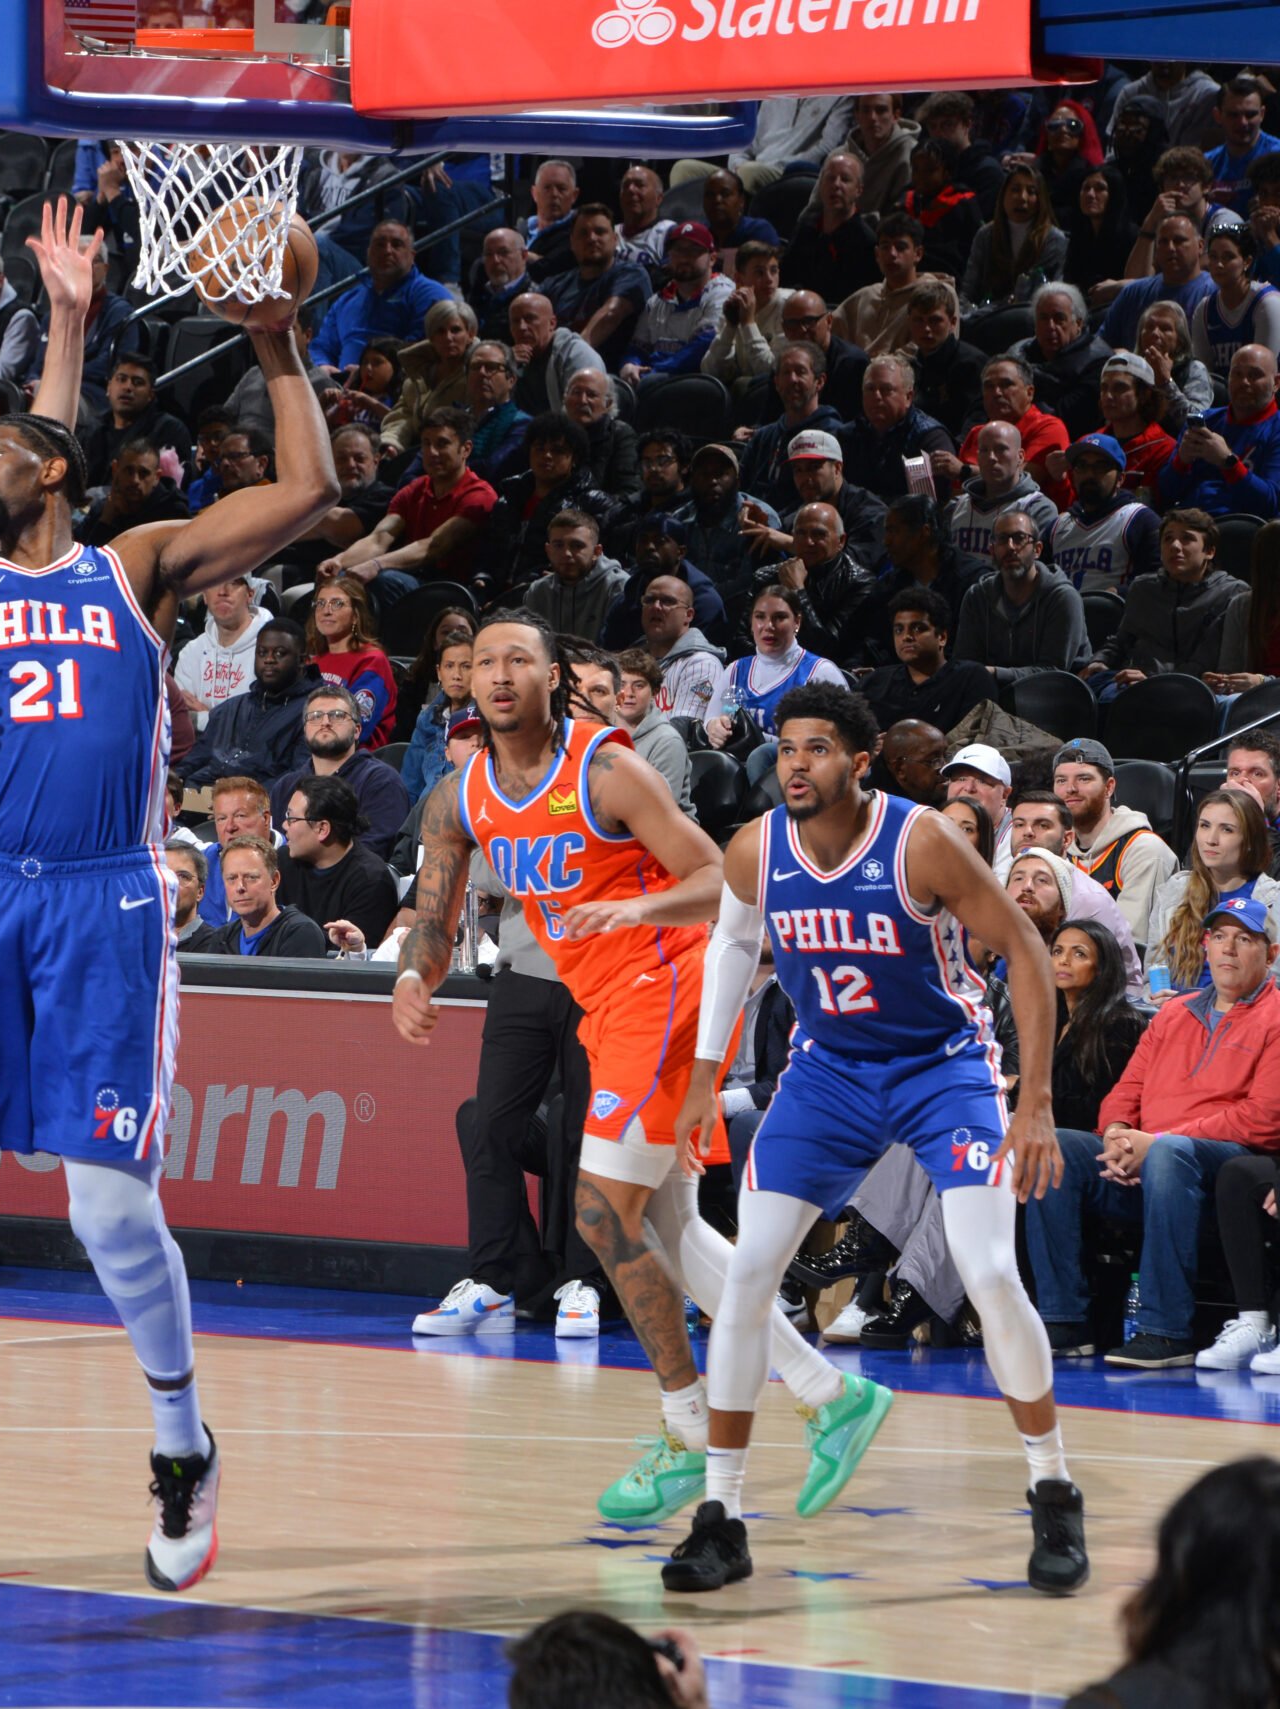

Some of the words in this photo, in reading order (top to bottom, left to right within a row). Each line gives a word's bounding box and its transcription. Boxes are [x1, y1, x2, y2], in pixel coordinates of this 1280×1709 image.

[67, 575, 111, 585] crypto.com
[9, 658, 84, 722] 21
[489, 831, 588, 896] OKC
[854, 884, 893, 892] crypto.com
[1225, 899, 1247, 910] 76
[770, 909, 904, 956] PHILA
[811, 966, 879, 1015] 12
[93, 1106, 138, 1142] 76
[951, 1141, 990, 1172] 76
